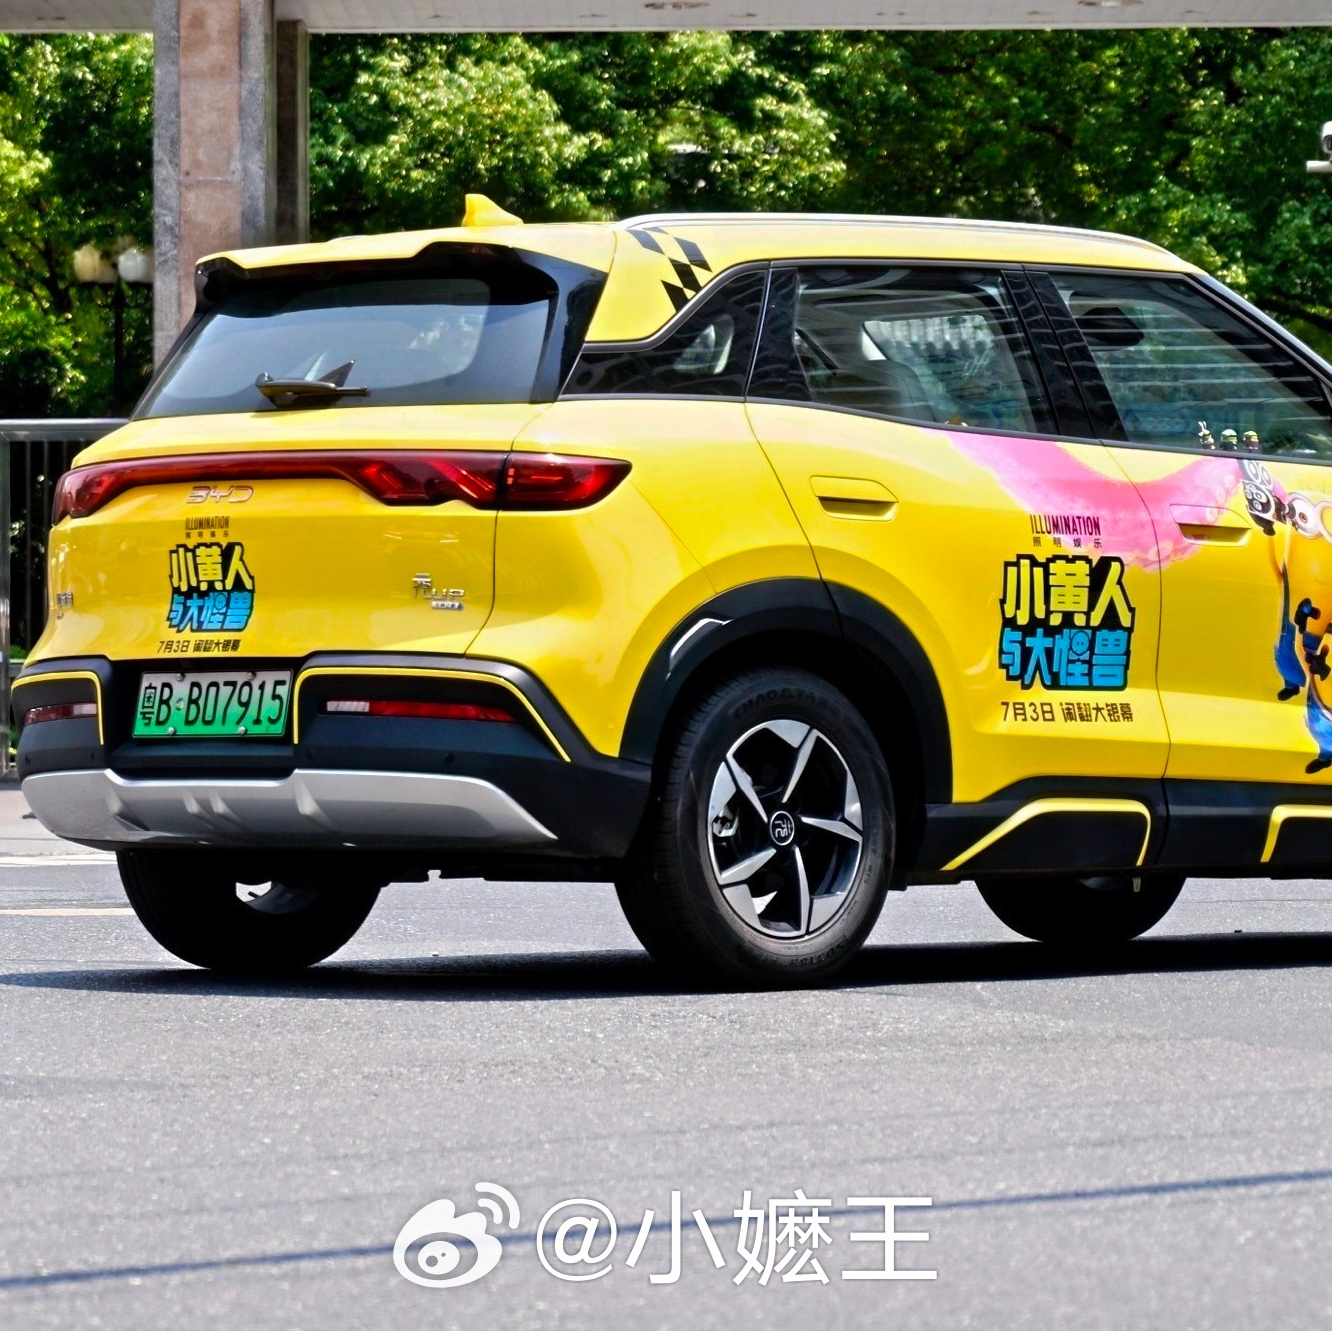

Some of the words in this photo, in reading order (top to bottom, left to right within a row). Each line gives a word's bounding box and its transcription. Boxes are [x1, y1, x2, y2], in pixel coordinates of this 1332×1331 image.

[186, 485, 254, 504] BYD
[185, 516, 230, 531] ILLUMINATION
[1029, 514, 1101, 536] ILLUMINATION
[1032, 536, 1102, 548] 照明娱乐
[170, 544, 254, 592] 小黄人
[1003, 557, 1133, 628] 小黄人
[169, 591, 252, 630] 与大怪兽
[157, 640, 190, 654] 7月3日
[1001, 627, 1129, 688] 与大怪兽
[1001, 701, 1055, 722] 7月3日
[1059, 702, 1134, 723] 闹翻大银幕
